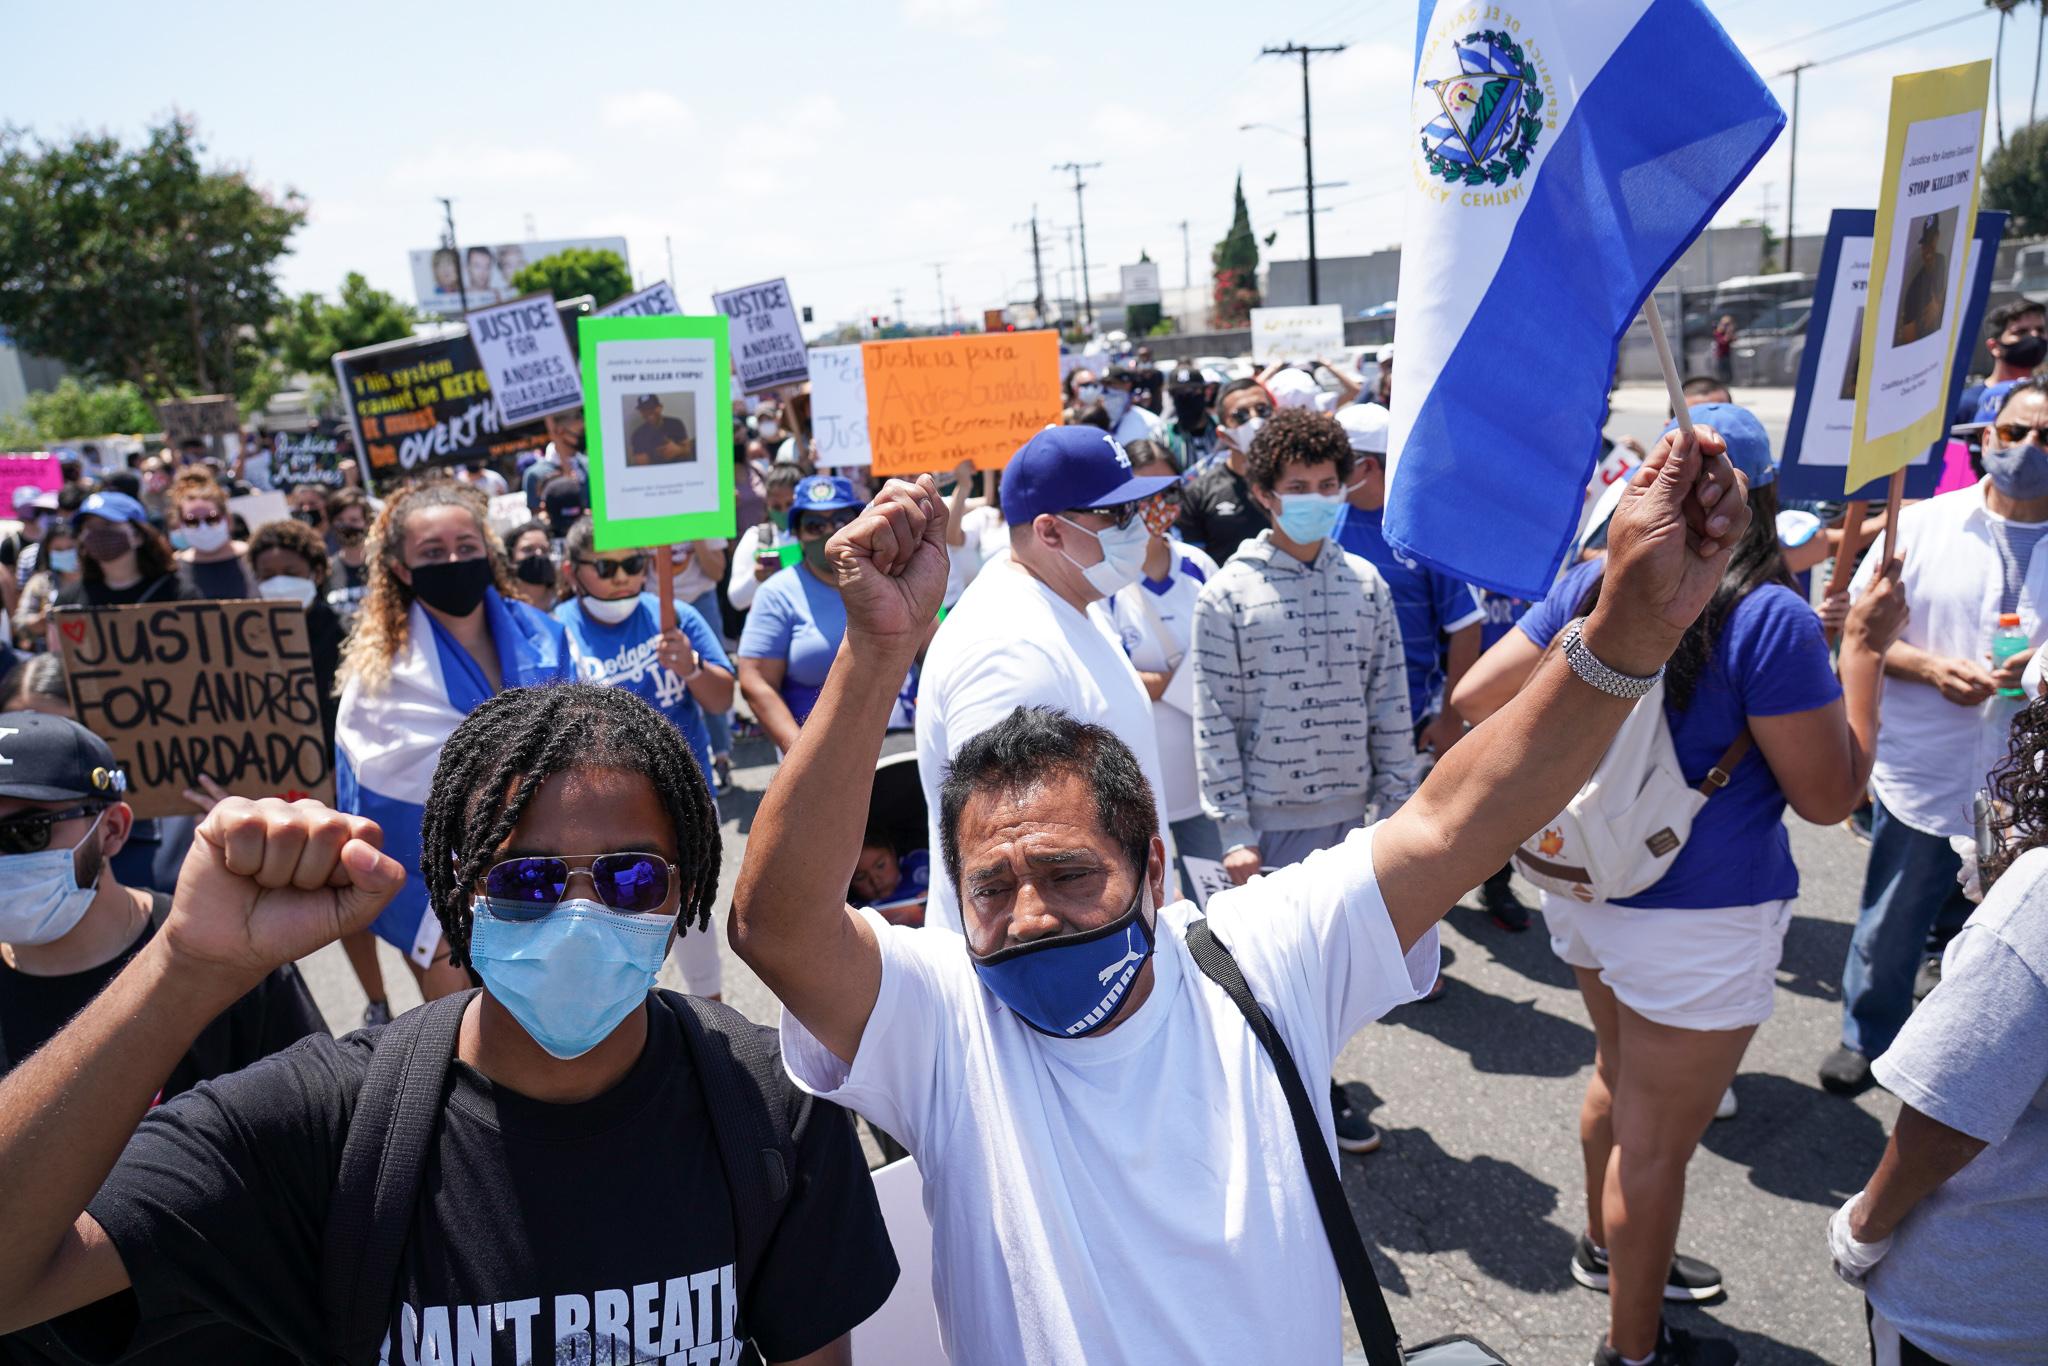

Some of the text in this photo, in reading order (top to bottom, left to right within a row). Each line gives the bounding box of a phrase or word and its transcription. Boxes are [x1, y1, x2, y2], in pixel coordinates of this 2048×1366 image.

[1907, 180, 1930, 197] STOP
[1931, 174, 1954, 192] KILLER
[476, 302, 553, 344] JUSTICE
[746, 313, 775, 335] FOR
[506, 334, 539, 358] FOR
[742, 334, 796, 358] ANDRES
[868, 344, 1020, 372] Justicia para
[353, 359, 453, 396] This system
[502, 355, 565, 385] ANDRES
[415, 385, 439, 406] be
[876, 424, 907, 451] NO
[60, 604, 311, 667] JUSTICE
[71, 664, 318, 731] FOR ANDRES
[645, 661, 686, 708] LA
[1300, 718, 1362, 729] Champion
[1066, 965, 1135, 1035] PUMA
[401, 1297, 540, 1366] CAN'T
